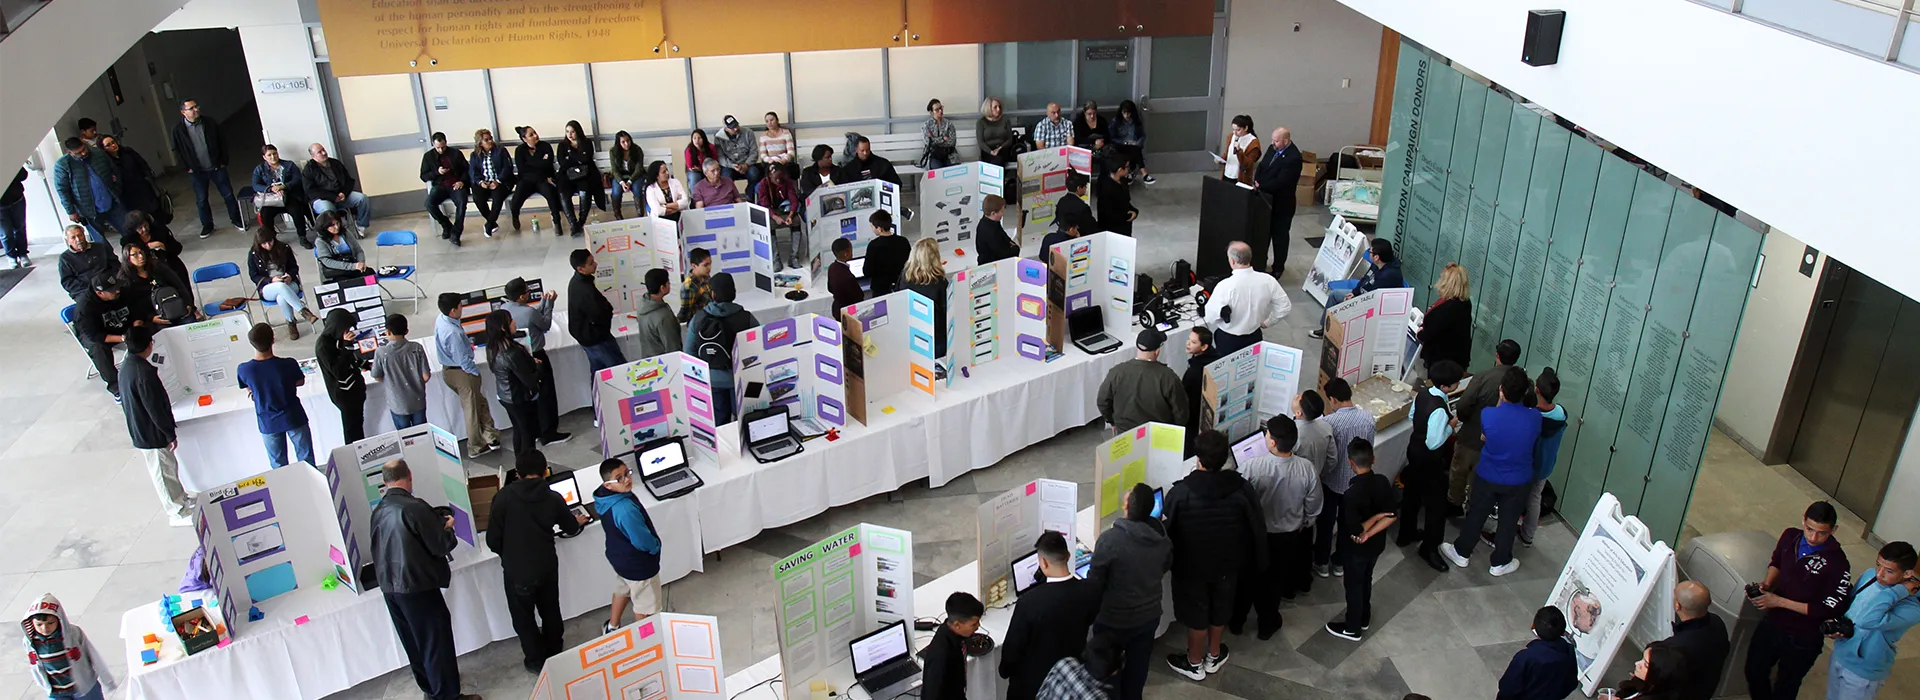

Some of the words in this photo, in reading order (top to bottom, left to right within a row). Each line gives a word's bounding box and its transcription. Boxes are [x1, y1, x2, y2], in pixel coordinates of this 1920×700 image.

[372, 0, 422, 8] Education
[374, 14, 385, 22] of
[389, 12, 406, 21] the
[409, 10, 443, 20] human
[447, 7, 502, 20] personality
[507, 6, 526, 15] and
[529, 5, 540, 14] to
[543, 4, 560, 13] the
[563, 1, 630, 12] strengthening
[634, 0, 645, 8] of
[377, 26, 414, 36] respect
[418, 24, 433, 34] for
[436, 21, 471, 33] human
[474, 20, 503, 31] rights
[506, 18, 526, 28] and
[529, 16, 592, 27] fundamental
[595, 14, 644, 24] freedoms.
[380, 40, 427, 50] Universal
[431, 35, 491, 47] Declaration
[494, 34, 505, 43] of
[508, 32, 545, 42] Human
[549, 29, 582, 41] Rights,
[586, 28, 611, 38] 1948
[1391, 189, 1409, 258] EDUCATION
[1402, 119, 1418, 187] CAMPAIGN
[1411, 59, 1427, 117] DONORS
[1339, 300, 1359, 312] HOCKEY
[1361, 293, 1376, 302] TABLE
[360, 443, 387, 461] verizon
[822, 533, 855, 553] WATER
[778, 551, 813, 573] SAVING
[1836, 570, 1851, 596] NEW
